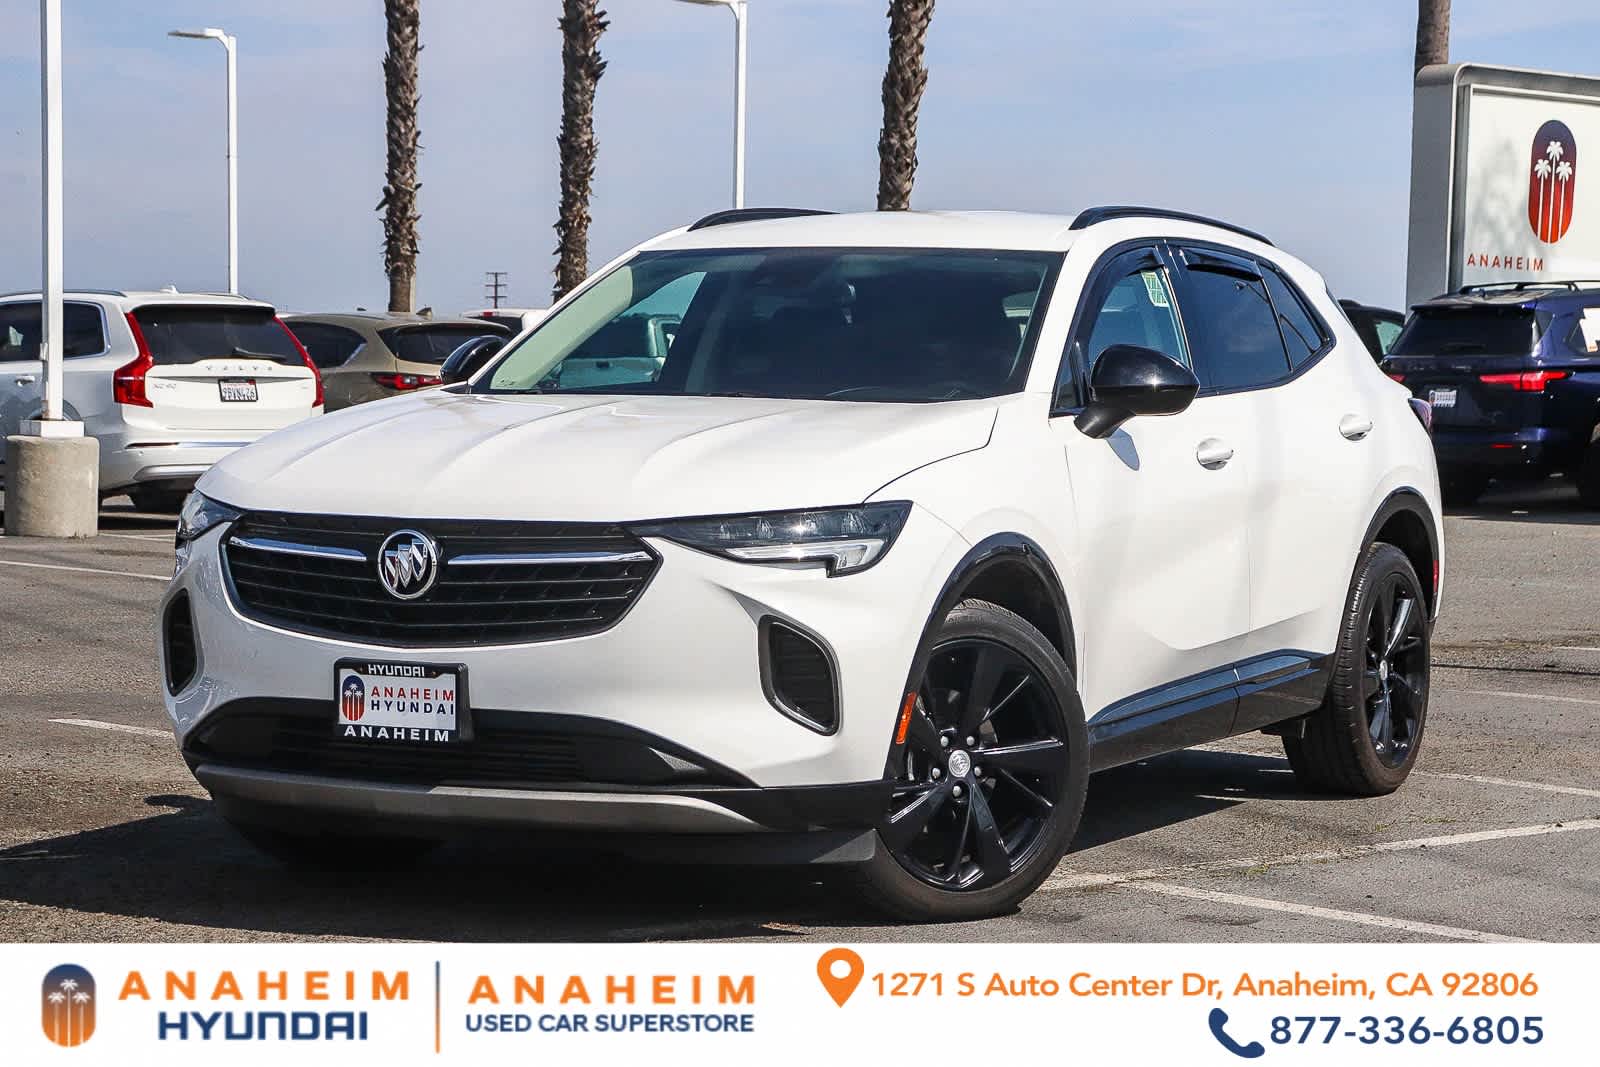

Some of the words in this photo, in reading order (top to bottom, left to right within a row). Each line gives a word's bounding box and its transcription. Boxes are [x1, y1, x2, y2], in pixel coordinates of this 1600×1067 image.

[1467, 253, 1545, 271] ANAHEIM
[368, 664, 425, 677] HYUNDAI
[371, 686, 454, 701] ANAHEIM
[371, 700, 454, 715] HYUNDAI
[344, 725, 449, 742] ANAHEIM
